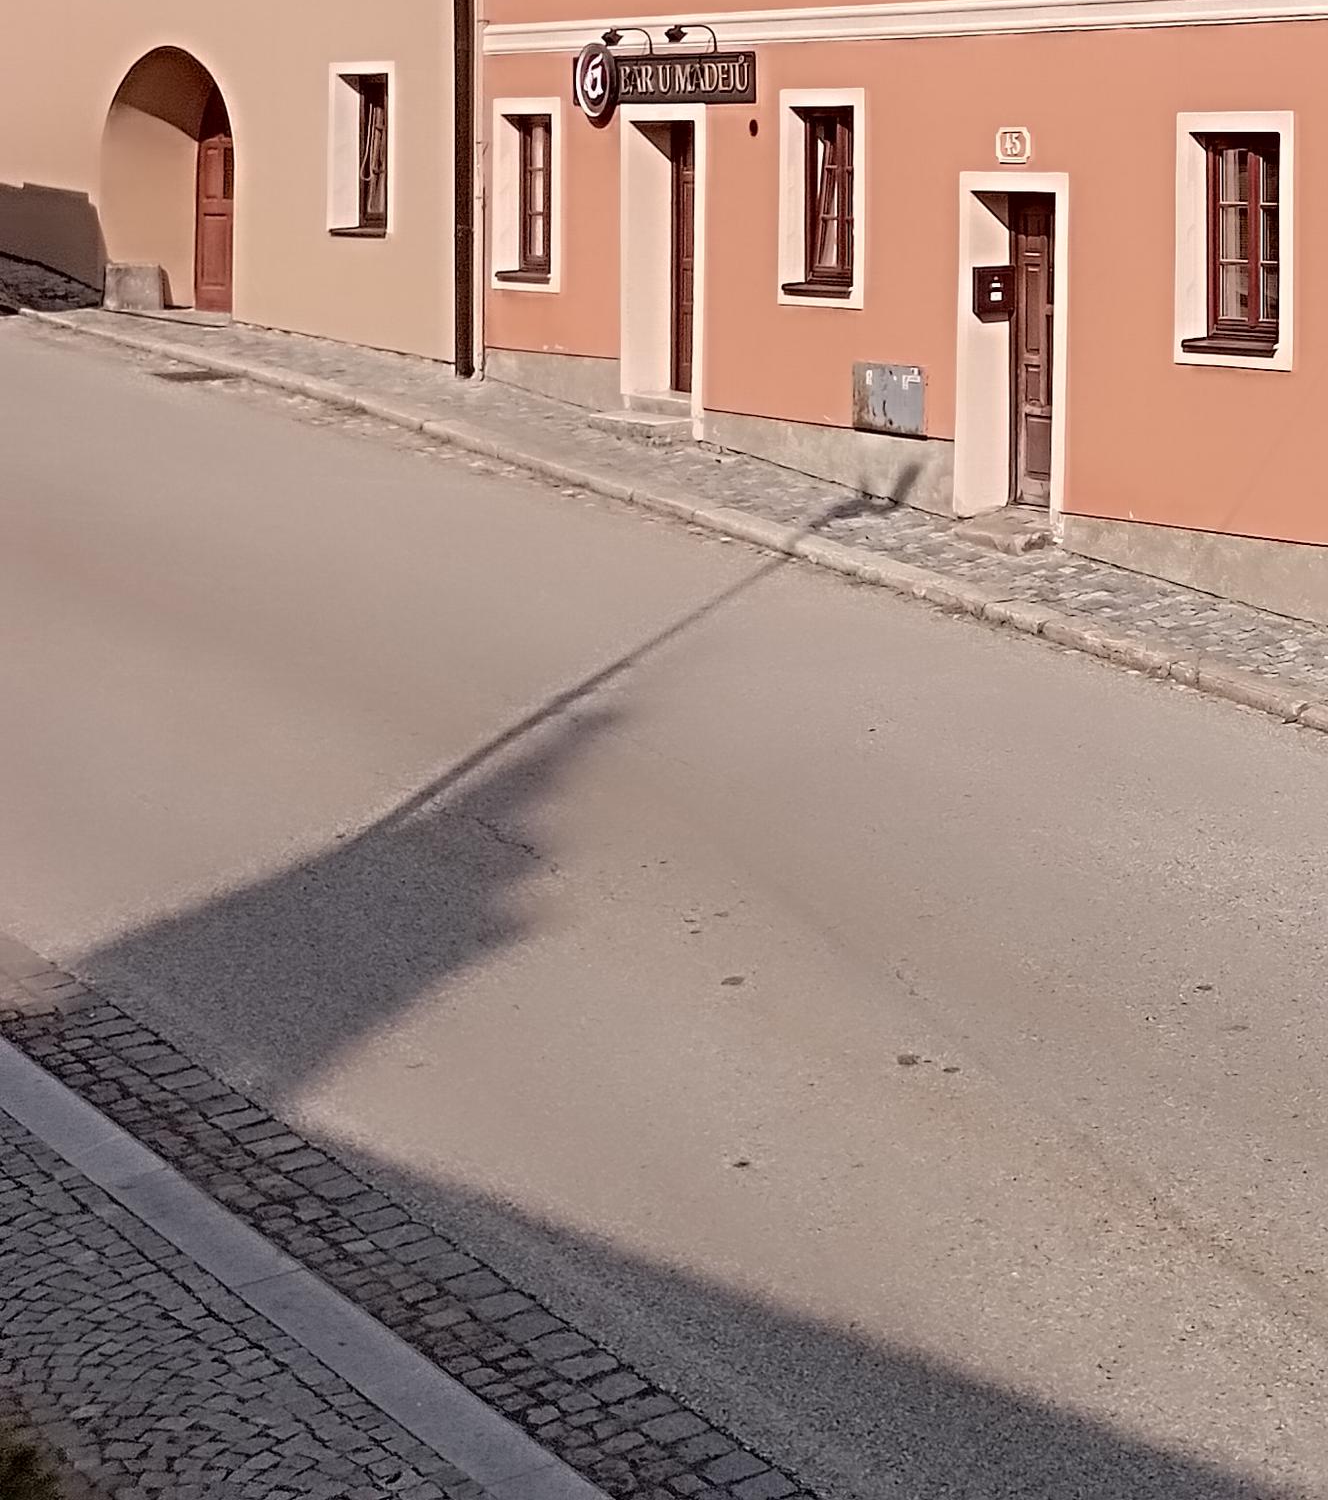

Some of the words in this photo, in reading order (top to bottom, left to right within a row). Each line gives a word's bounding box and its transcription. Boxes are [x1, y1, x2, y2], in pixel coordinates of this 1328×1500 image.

[620, 64, 655, 95] BAR
[658, 62, 673, 94] U
[675, 55, 750, 94] MADEJŮ
[1004, 132, 1021, 156] 45
